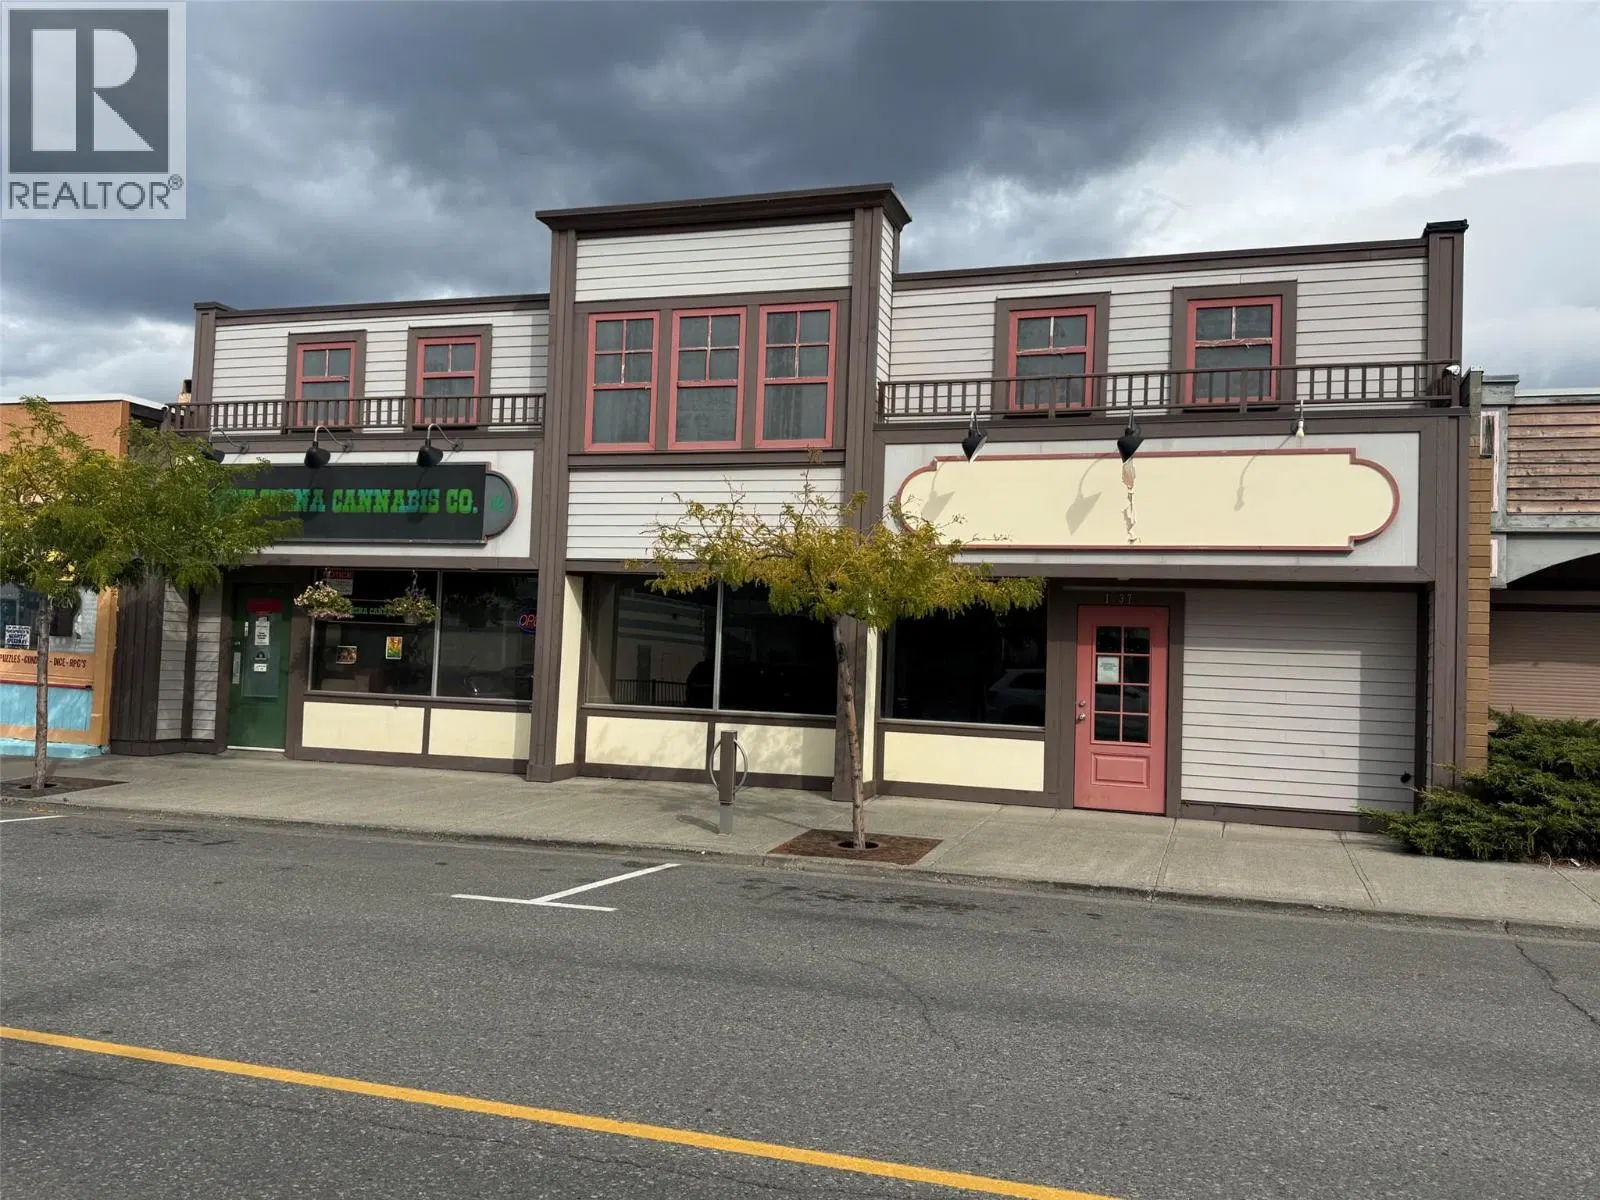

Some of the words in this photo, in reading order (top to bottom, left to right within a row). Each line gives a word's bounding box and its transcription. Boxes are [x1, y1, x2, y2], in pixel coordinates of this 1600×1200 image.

[331, 488, 441, 513] CANNABIS
[446, 488, 479, 514] CO.
[53, 657, 66, 667] DICE
